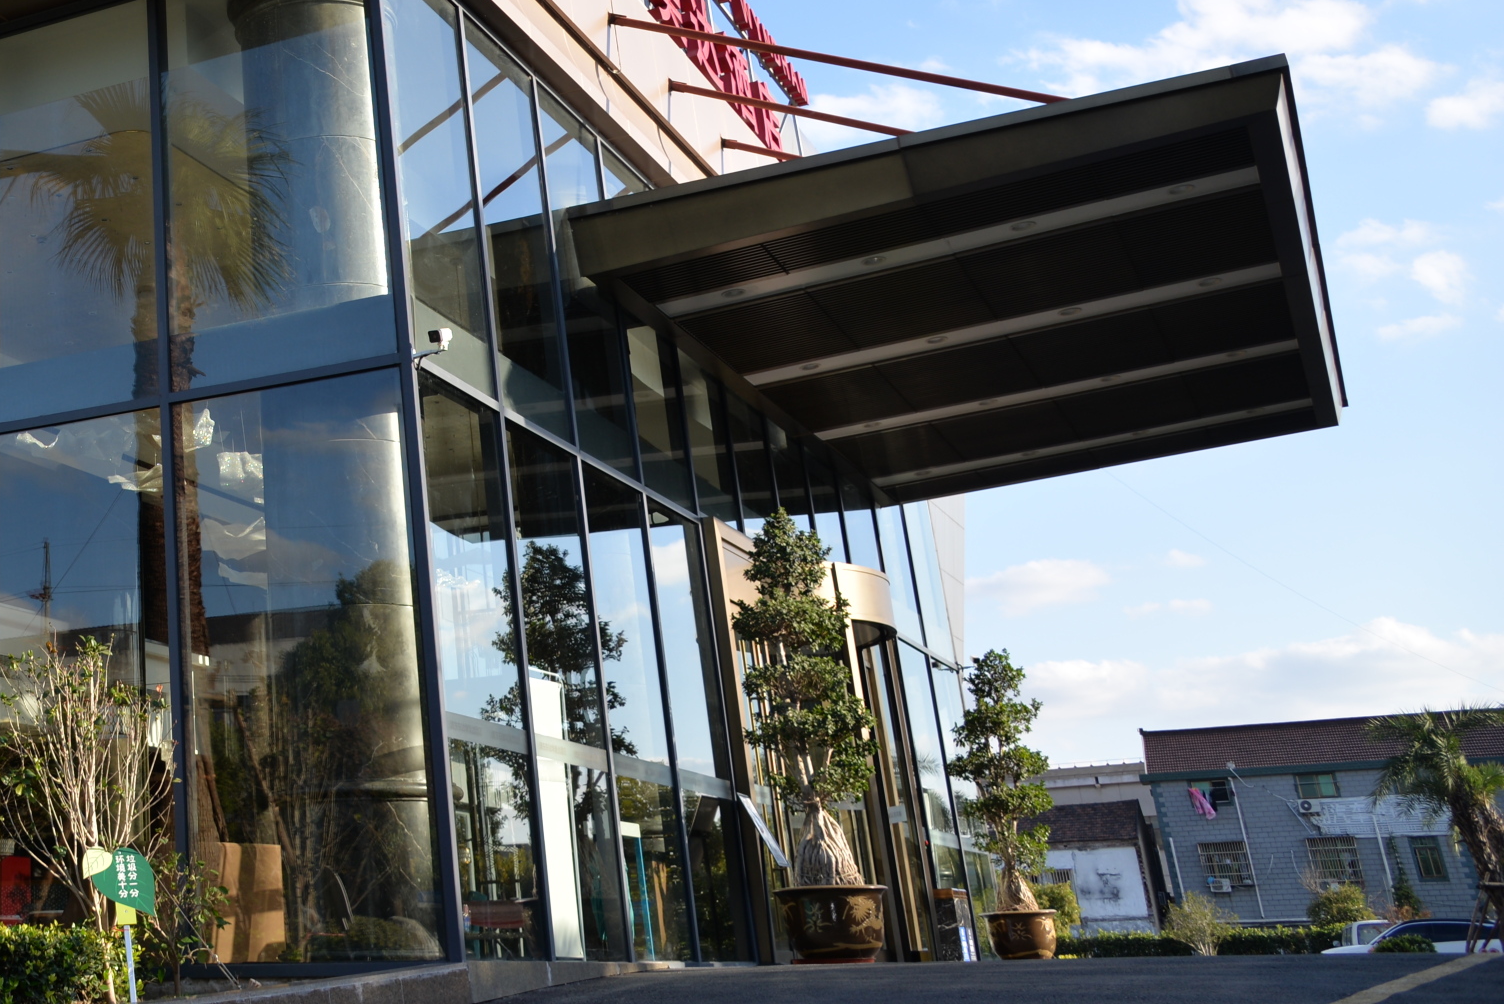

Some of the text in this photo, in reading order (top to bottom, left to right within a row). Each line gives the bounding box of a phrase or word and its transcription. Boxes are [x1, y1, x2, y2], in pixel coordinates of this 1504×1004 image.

[114, 854, 129, 899] 环境美十分
[125, 854, 140, 898] 垃圾分一分
